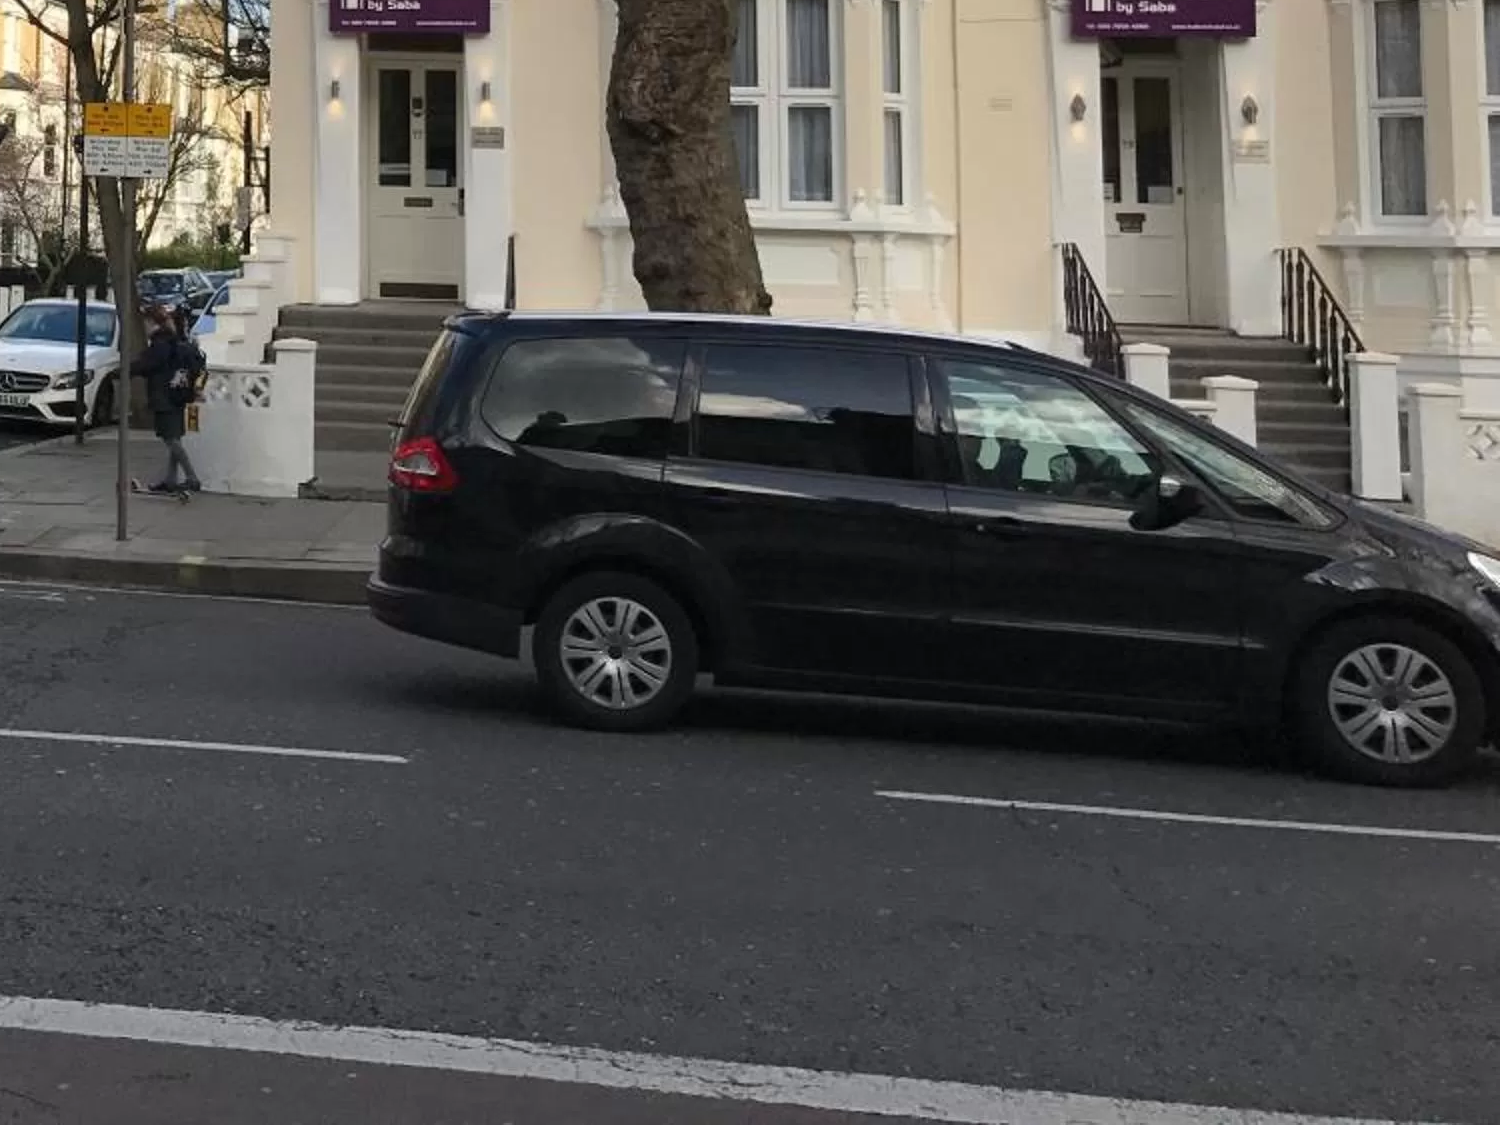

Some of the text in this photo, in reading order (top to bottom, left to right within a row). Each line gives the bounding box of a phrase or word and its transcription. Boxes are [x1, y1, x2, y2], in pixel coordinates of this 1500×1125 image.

[367, 0, 383, 11] by
[1115, 0, 1177, 15] by Saba
